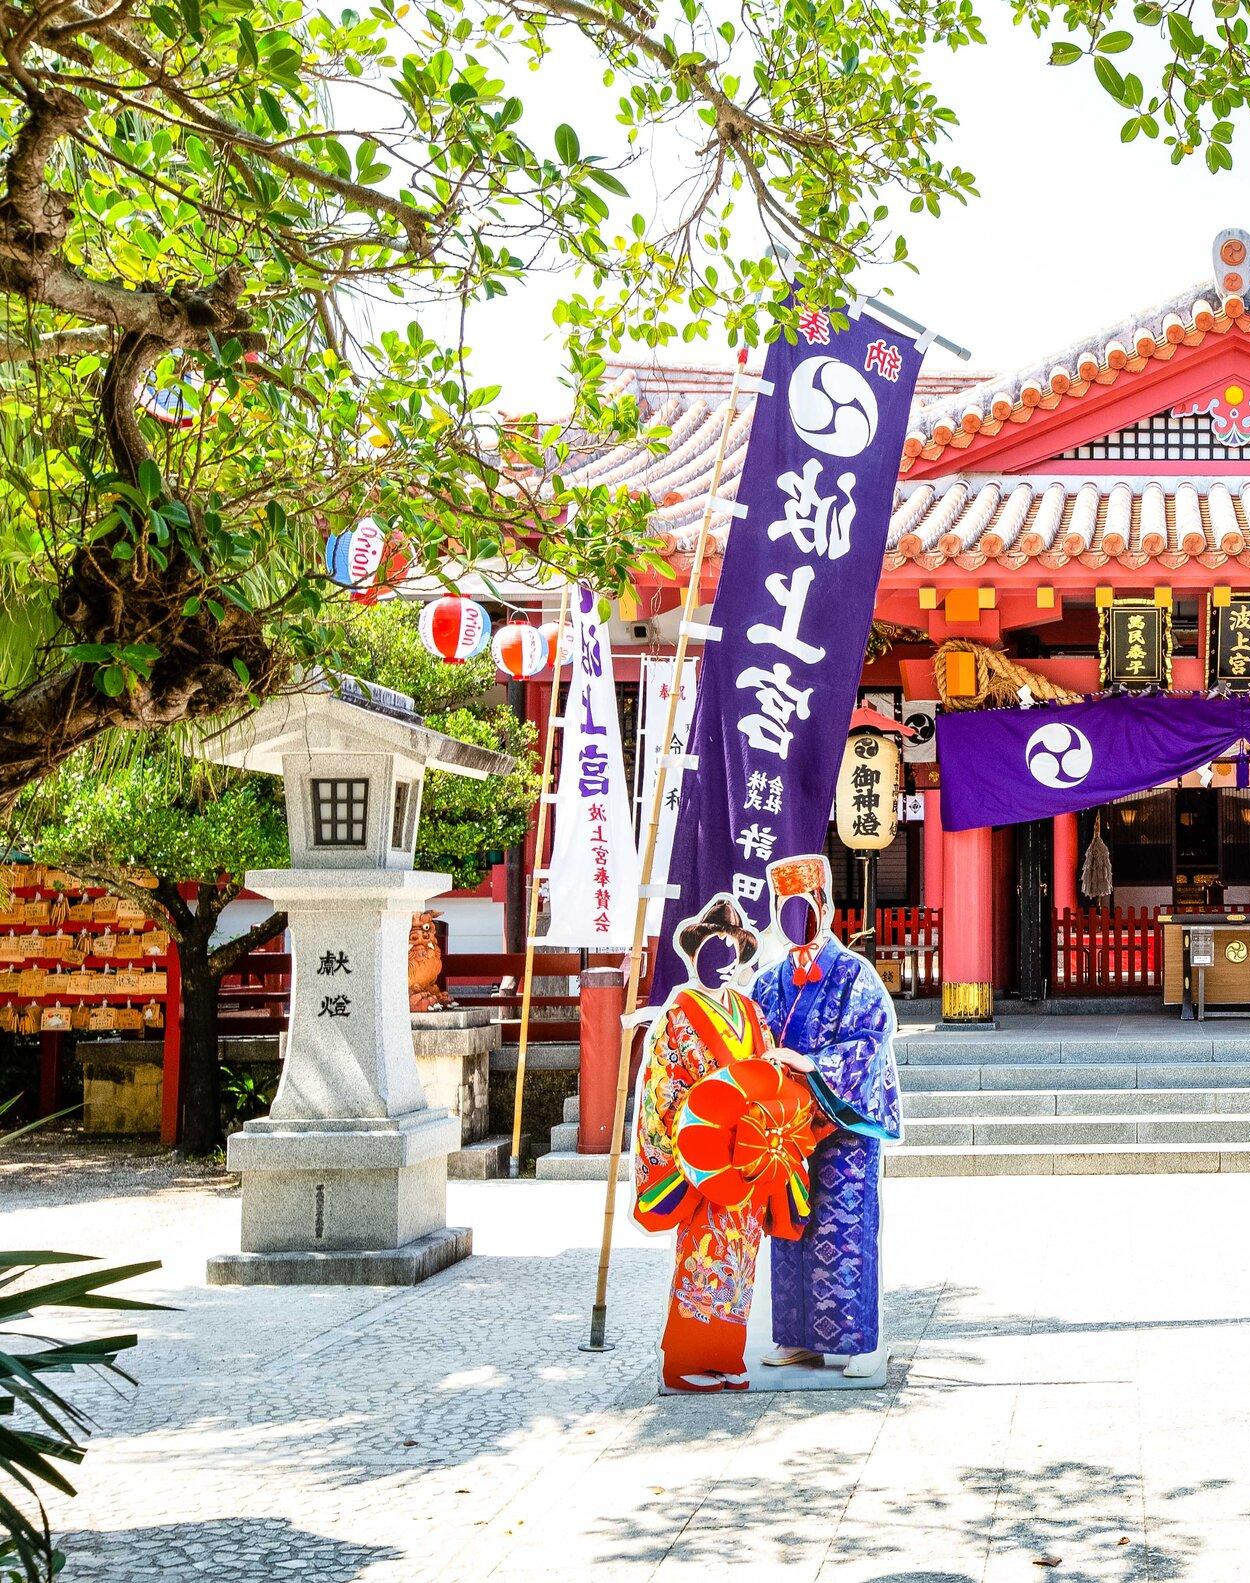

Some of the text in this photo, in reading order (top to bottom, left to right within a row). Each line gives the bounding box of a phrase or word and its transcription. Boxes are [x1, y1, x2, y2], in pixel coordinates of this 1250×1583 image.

[351, 526, 378, 578] Orion
[462, 608, 482, 646] Orion
[851, 764, 882, 838] 御神燈
